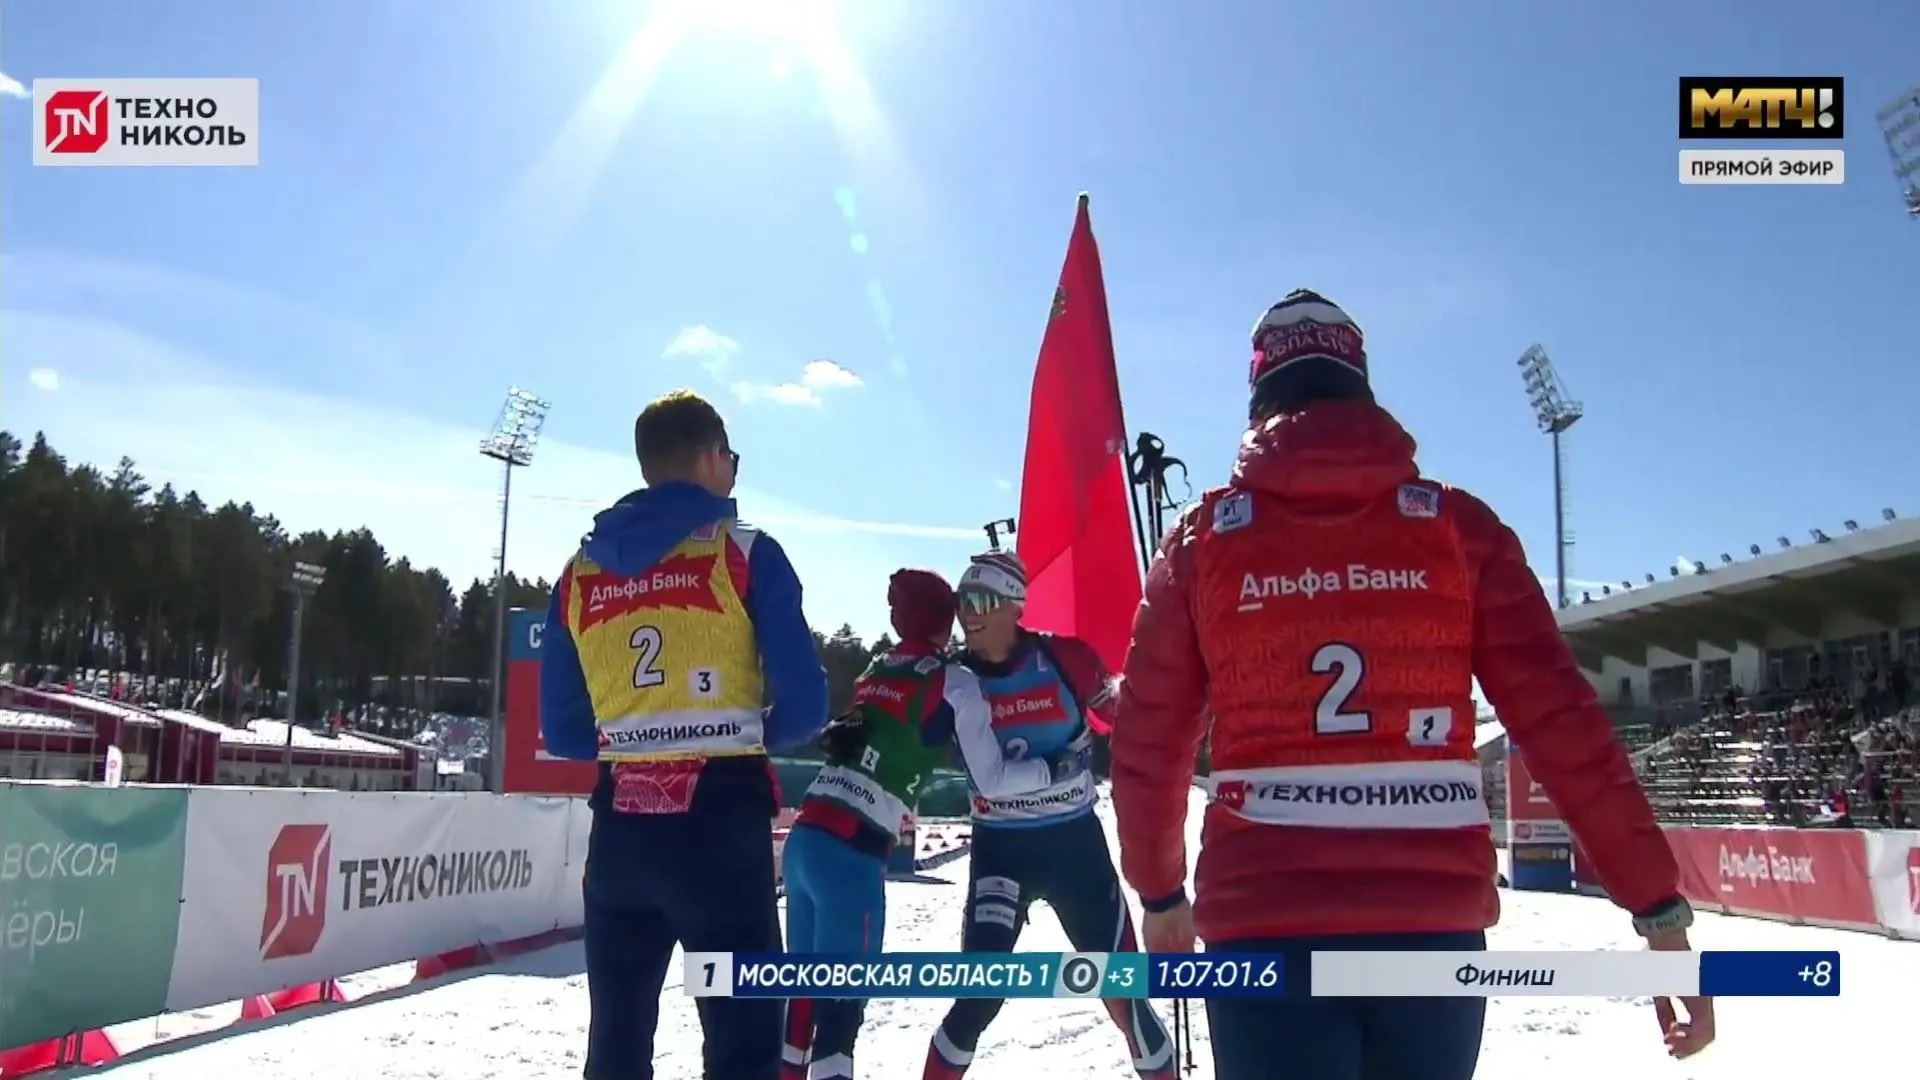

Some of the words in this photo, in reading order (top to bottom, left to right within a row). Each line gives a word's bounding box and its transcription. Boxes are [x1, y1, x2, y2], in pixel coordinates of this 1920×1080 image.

[589, 577, 648, 606] Альфа
[652, 572, 701, 590] Банк
[1239, 567, 1341, 602] Альфа
[1347, 564, 1429, 591] Банк
[629, 624, 665, 689] 2
[697, 671, 712, 692] 3
[1309, 641, 1373, 736] 2
[1016, 697, 1054, 713] Банк
[608, 721, 742, 744] ТЕХНОНИКОЛЬ
[906, 773, 920, 795] 2
[1257, 781, 1478, 806] ТЕХНОНИКОЛЬ
[0, 842, 118, 880] вская
[338, 848, 534, 911] ТЕХНОНИКОЛЬ
[1719, 843, 1769, 890] Альфа
[1768, 845, 1816, 884] Банк
[0, 898, 84, 964] ёры
